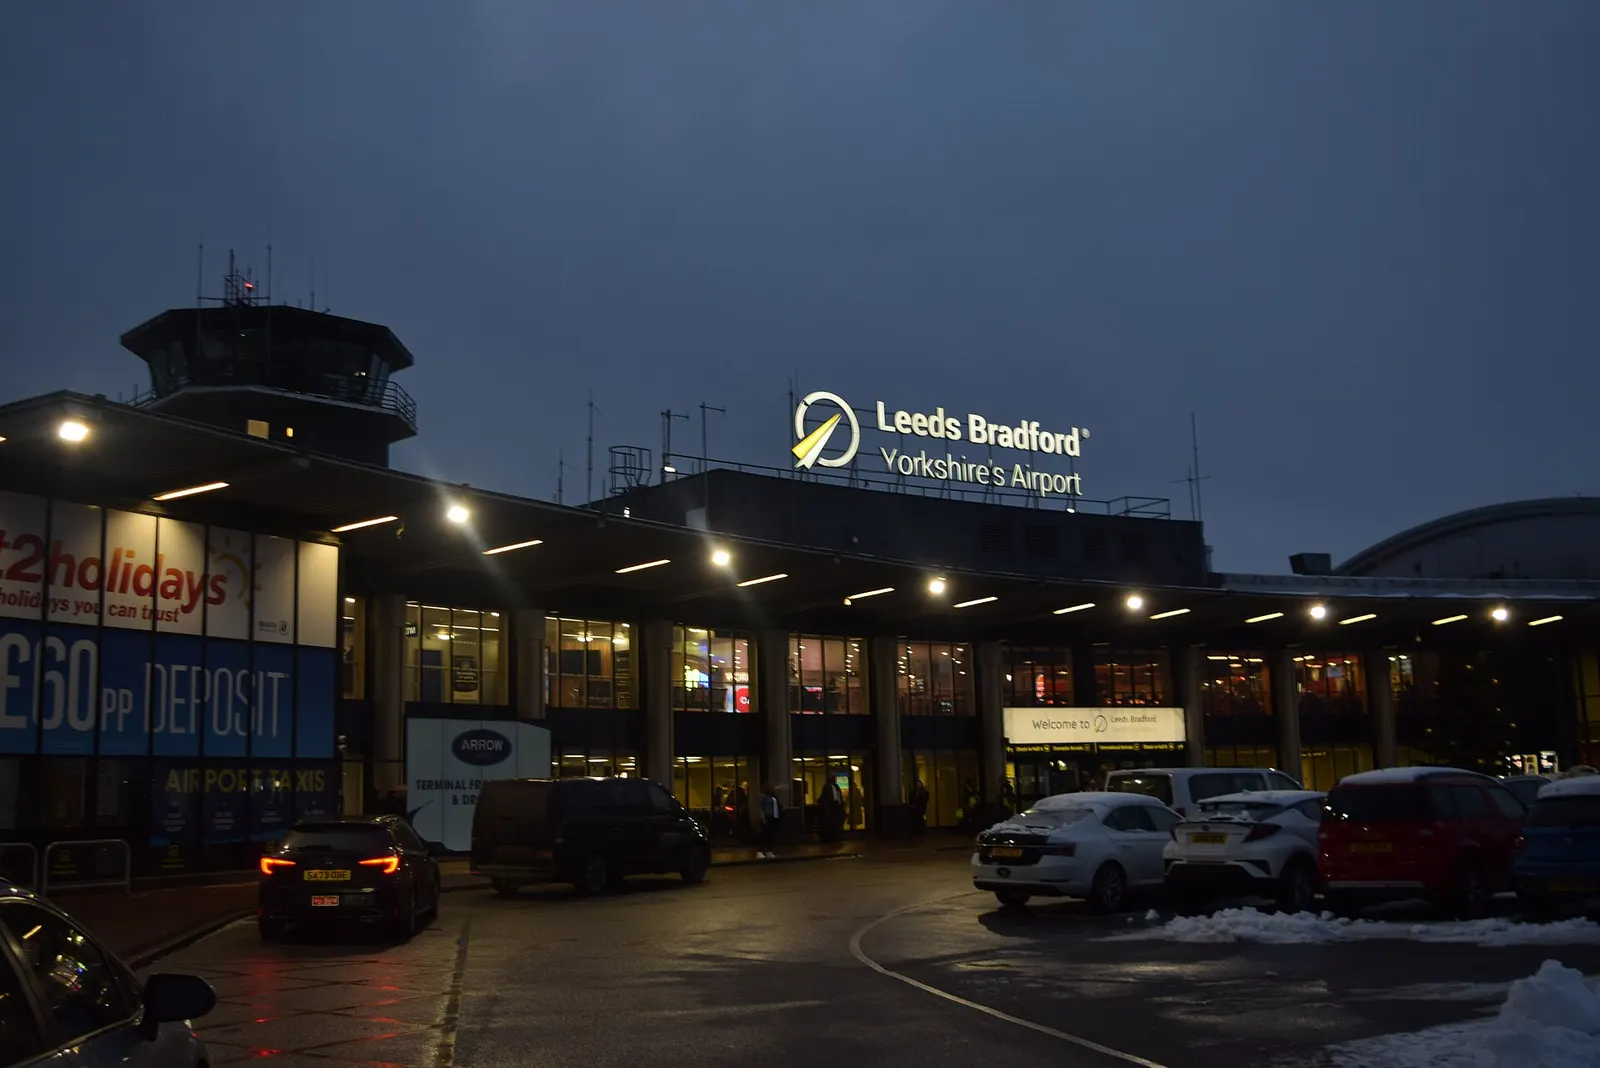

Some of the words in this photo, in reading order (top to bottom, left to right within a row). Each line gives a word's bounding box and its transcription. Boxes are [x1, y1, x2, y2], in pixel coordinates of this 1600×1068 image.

[876, 400, 962, 441] Leeds
[880, 446, 1005, 487] Yorkshire's
[1010, 463, 1082, 497] Airport
[74, 601, 101, 616] you
[108, 604, 137, 619] can
[141, 605, 179, 622] trust
[1032, 719, 1077, 730] Welcome
[1079, 720, 1091, 730] to
[1111, 715, 1129, 723] Leeds
[1130, 715, 1157, 723] Bradford
[461, 739, 504, 751] ARROW
[164, 768, 263, 793] AIRPORT
[268, 768, 326, 793] TAXIS
[416, 780, 467, 791] TERMINAL
[469, 780, 482, 791] FR
[452, 795, 460, 805] &
[462, 795, 480, 805] DR
